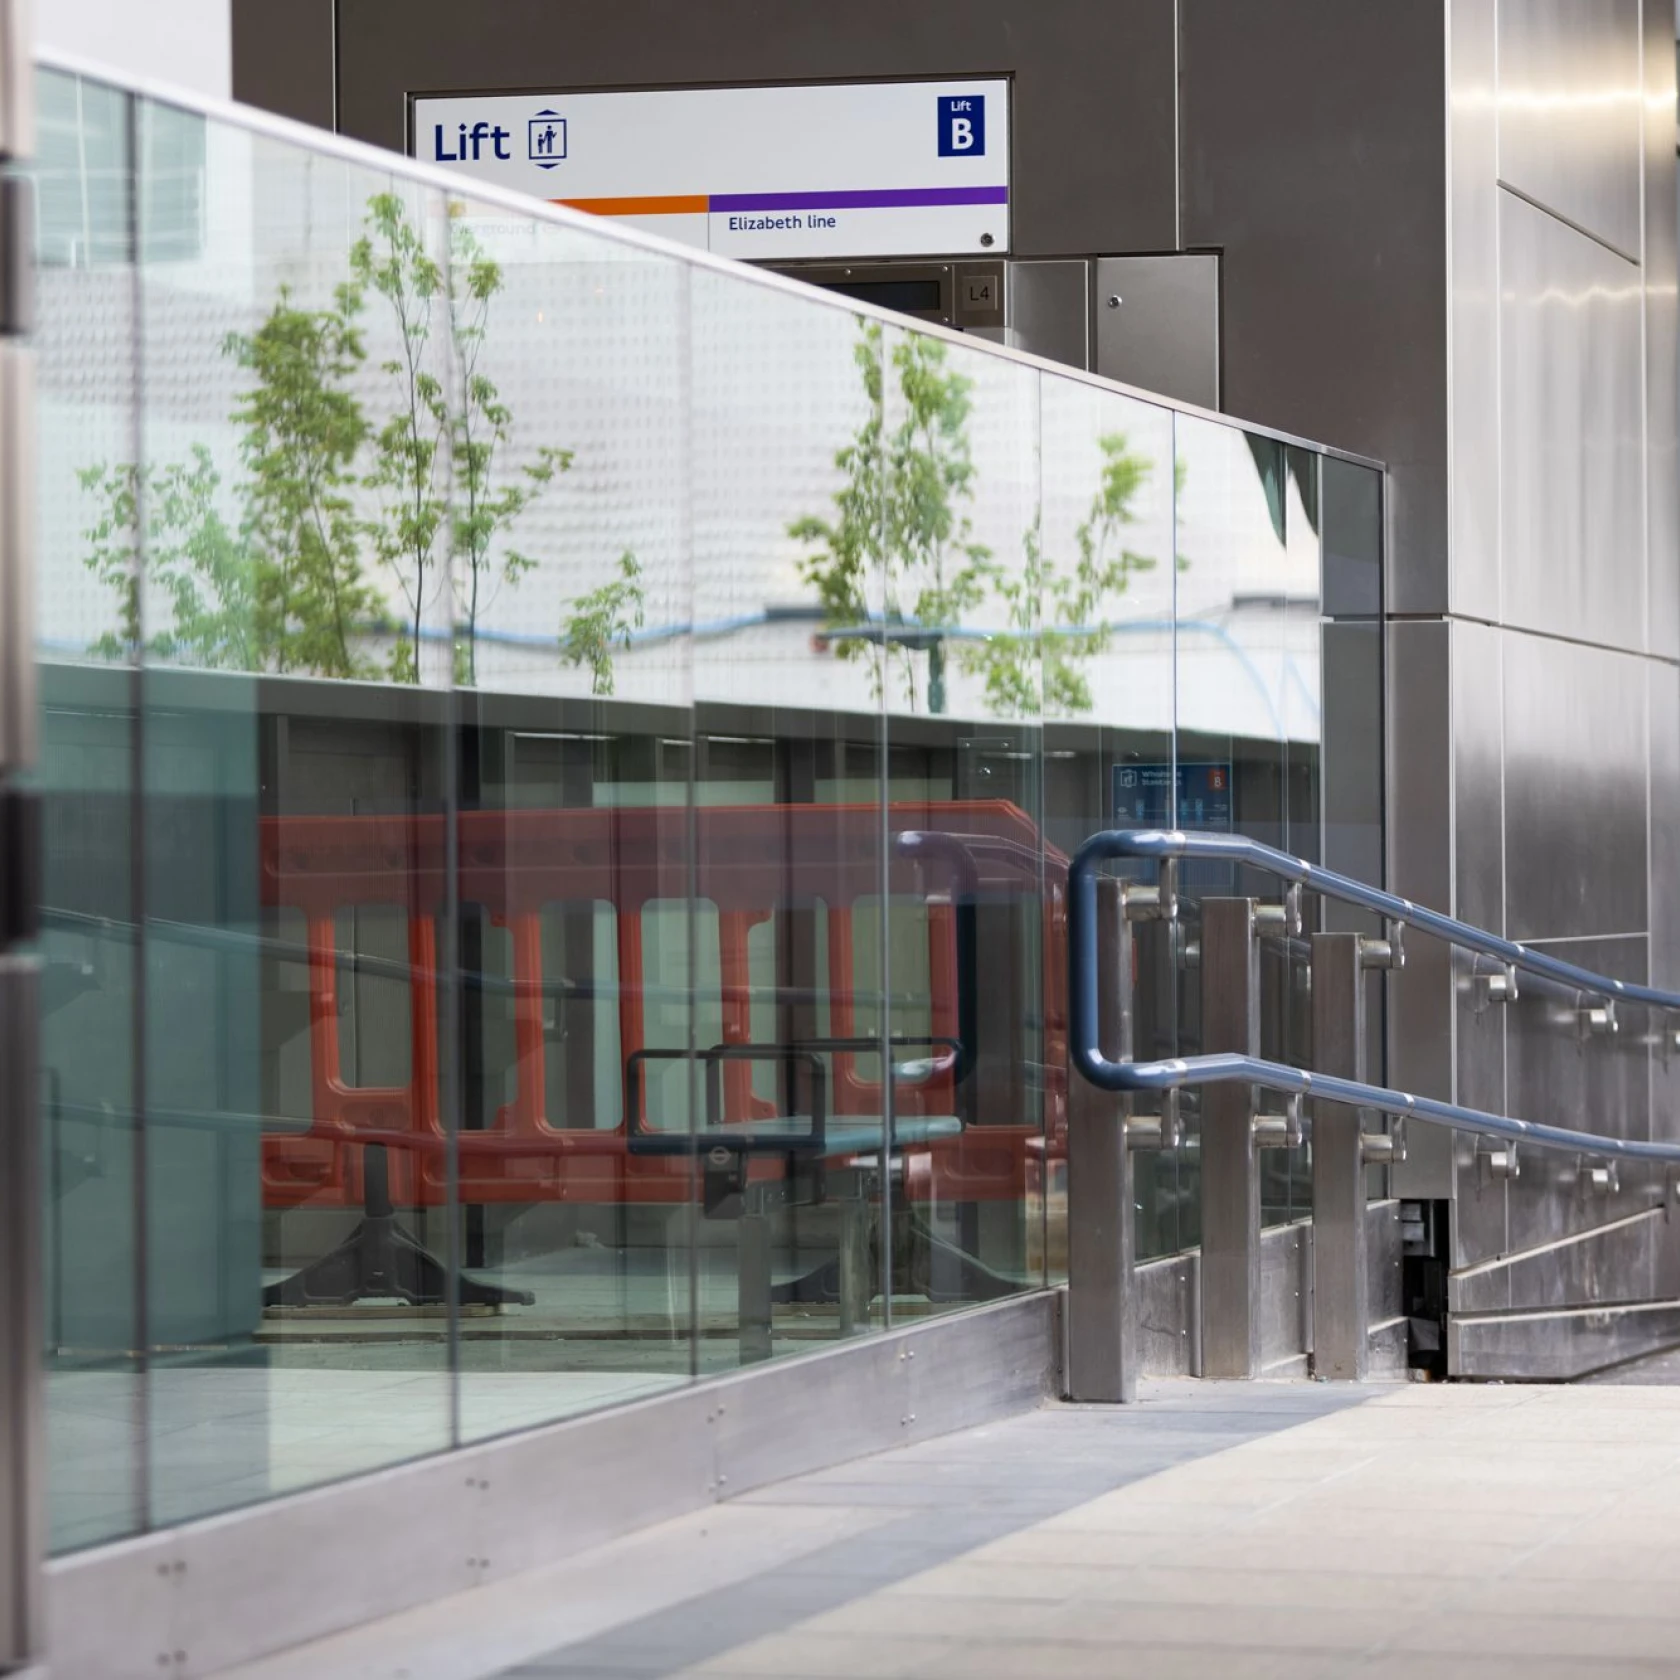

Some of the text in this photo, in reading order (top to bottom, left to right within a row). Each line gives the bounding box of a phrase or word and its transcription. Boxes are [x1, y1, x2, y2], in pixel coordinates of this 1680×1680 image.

[951, 100, 972, 112] Lift
[434, 121, 511, 162] Lift
[951, 117, 974, 150] B
[729, 214, 836, 231] Elizabeth line
[970, 285, 989, 301] L4
